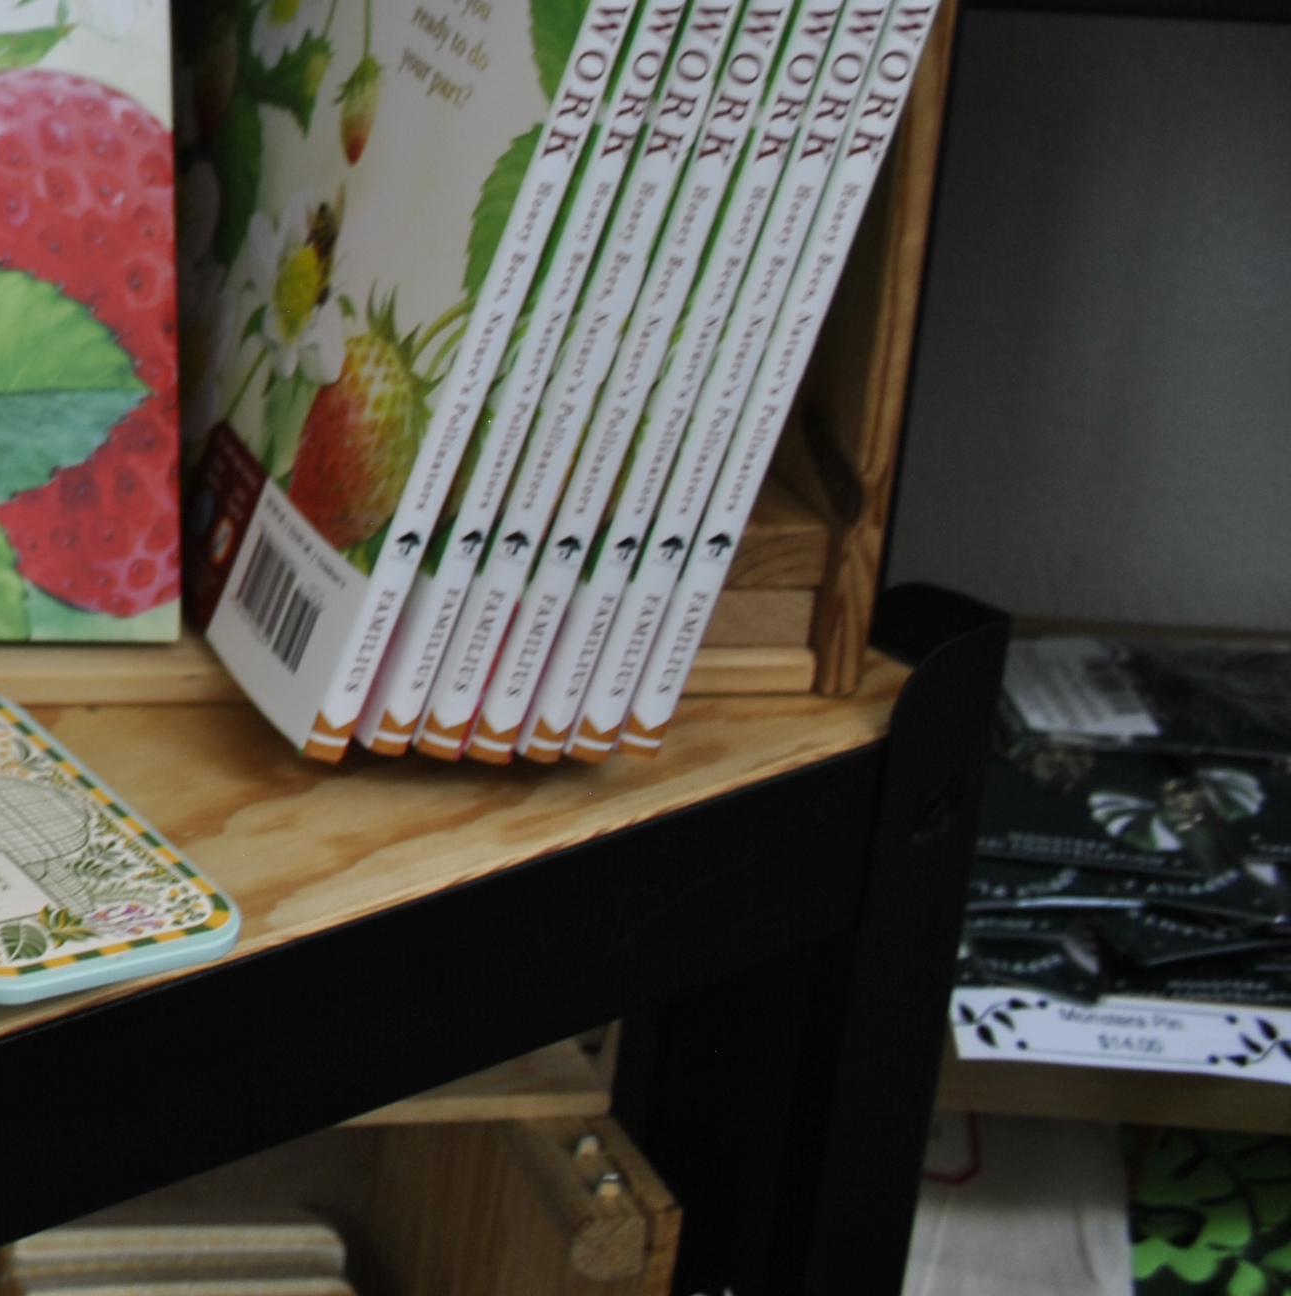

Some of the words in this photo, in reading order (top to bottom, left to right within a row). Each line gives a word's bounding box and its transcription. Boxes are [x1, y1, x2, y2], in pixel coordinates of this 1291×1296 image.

[541, 6, 628, 164] WORK
[599, 6, 681, 164] WORK
[643, 5, 729, 164] WORK
[696, 7, 782, 165] WORK
[755, 8, 837, 165] WORK
[798, 8, 884, 165] WORK
[845, 6, 931, 164] WORK
